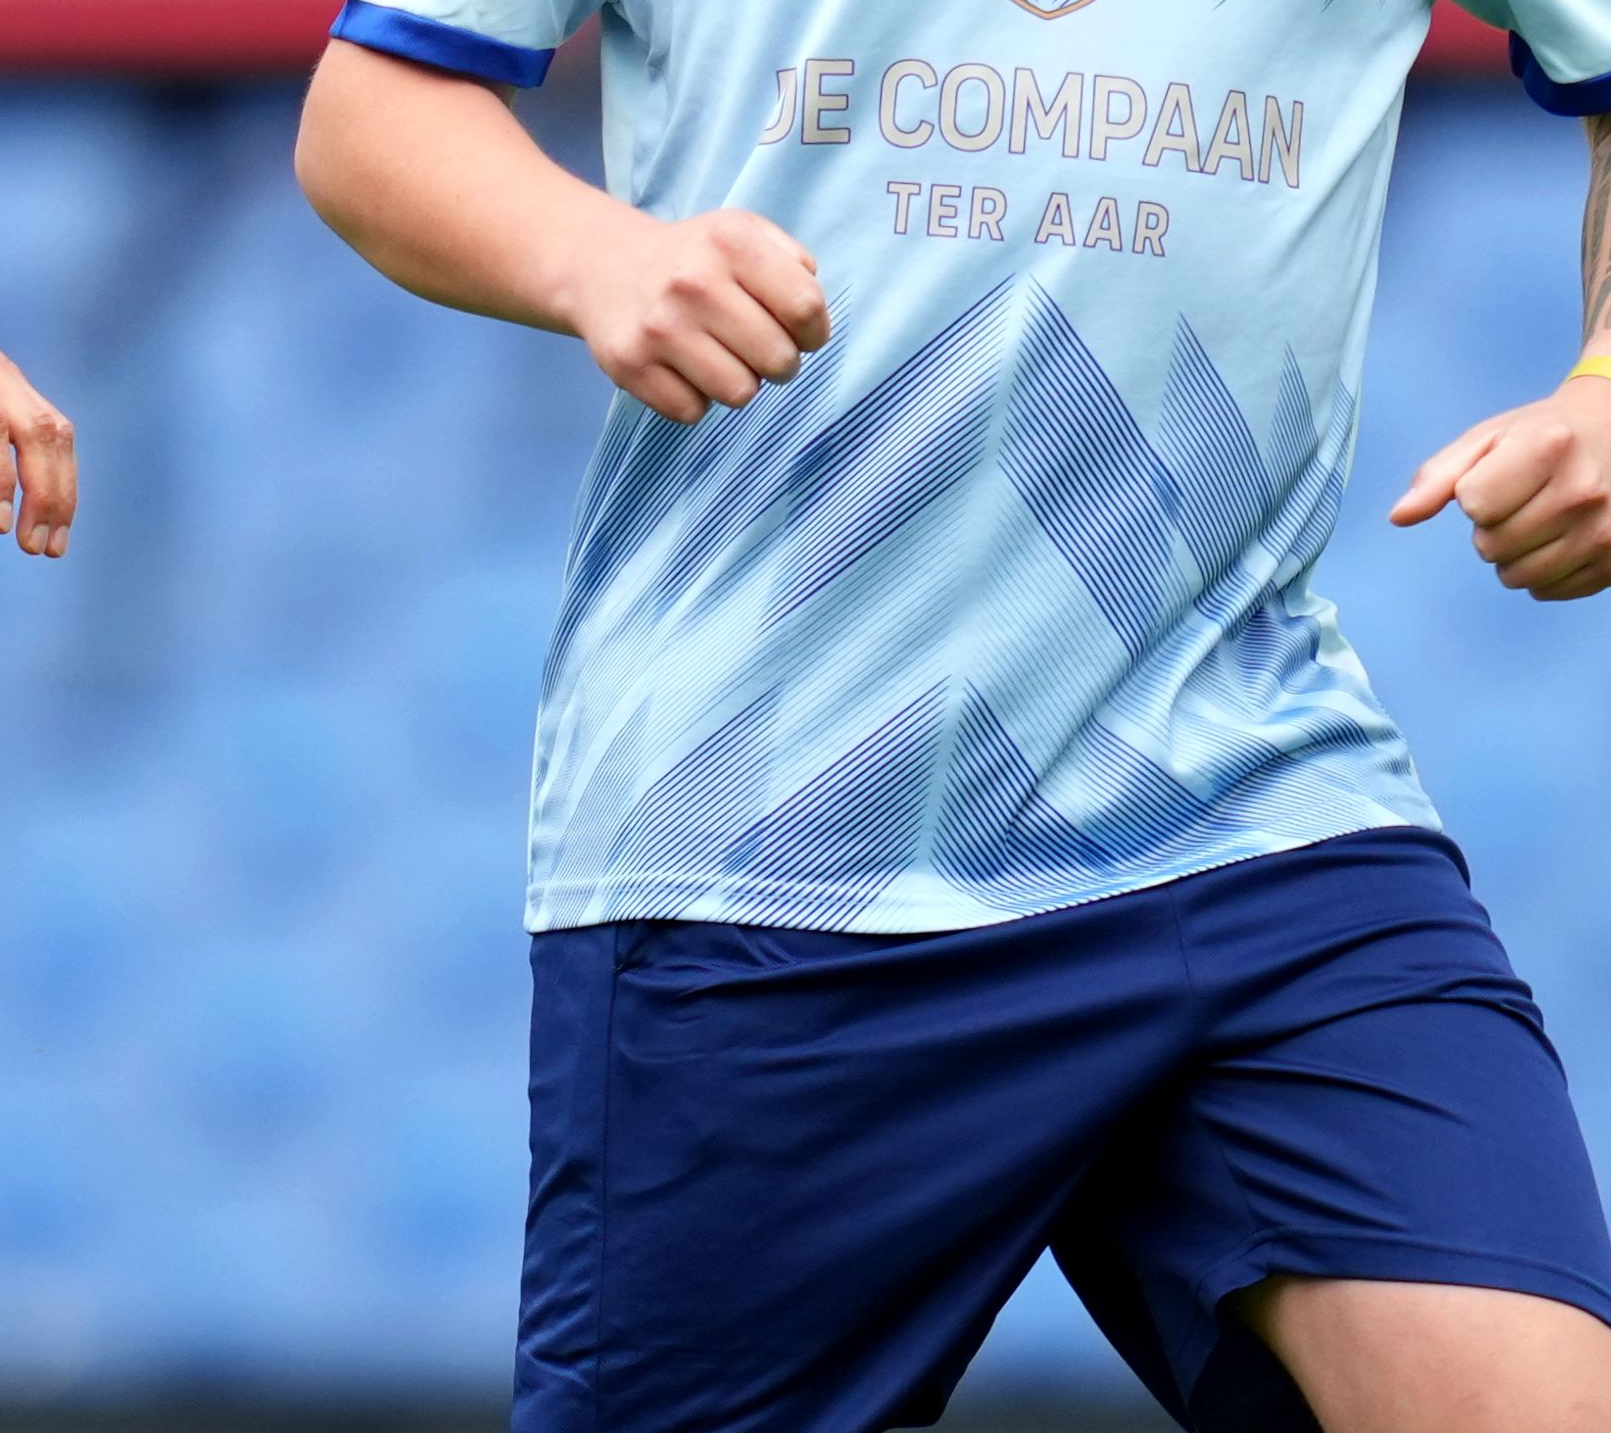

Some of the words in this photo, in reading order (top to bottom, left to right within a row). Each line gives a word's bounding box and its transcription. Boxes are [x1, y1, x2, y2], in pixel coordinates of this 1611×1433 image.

[877, 58, 1304, 189] COMPAAN
[886, 180, 1009, 242] TER
[1033, 191, 1171, 258] AAR
